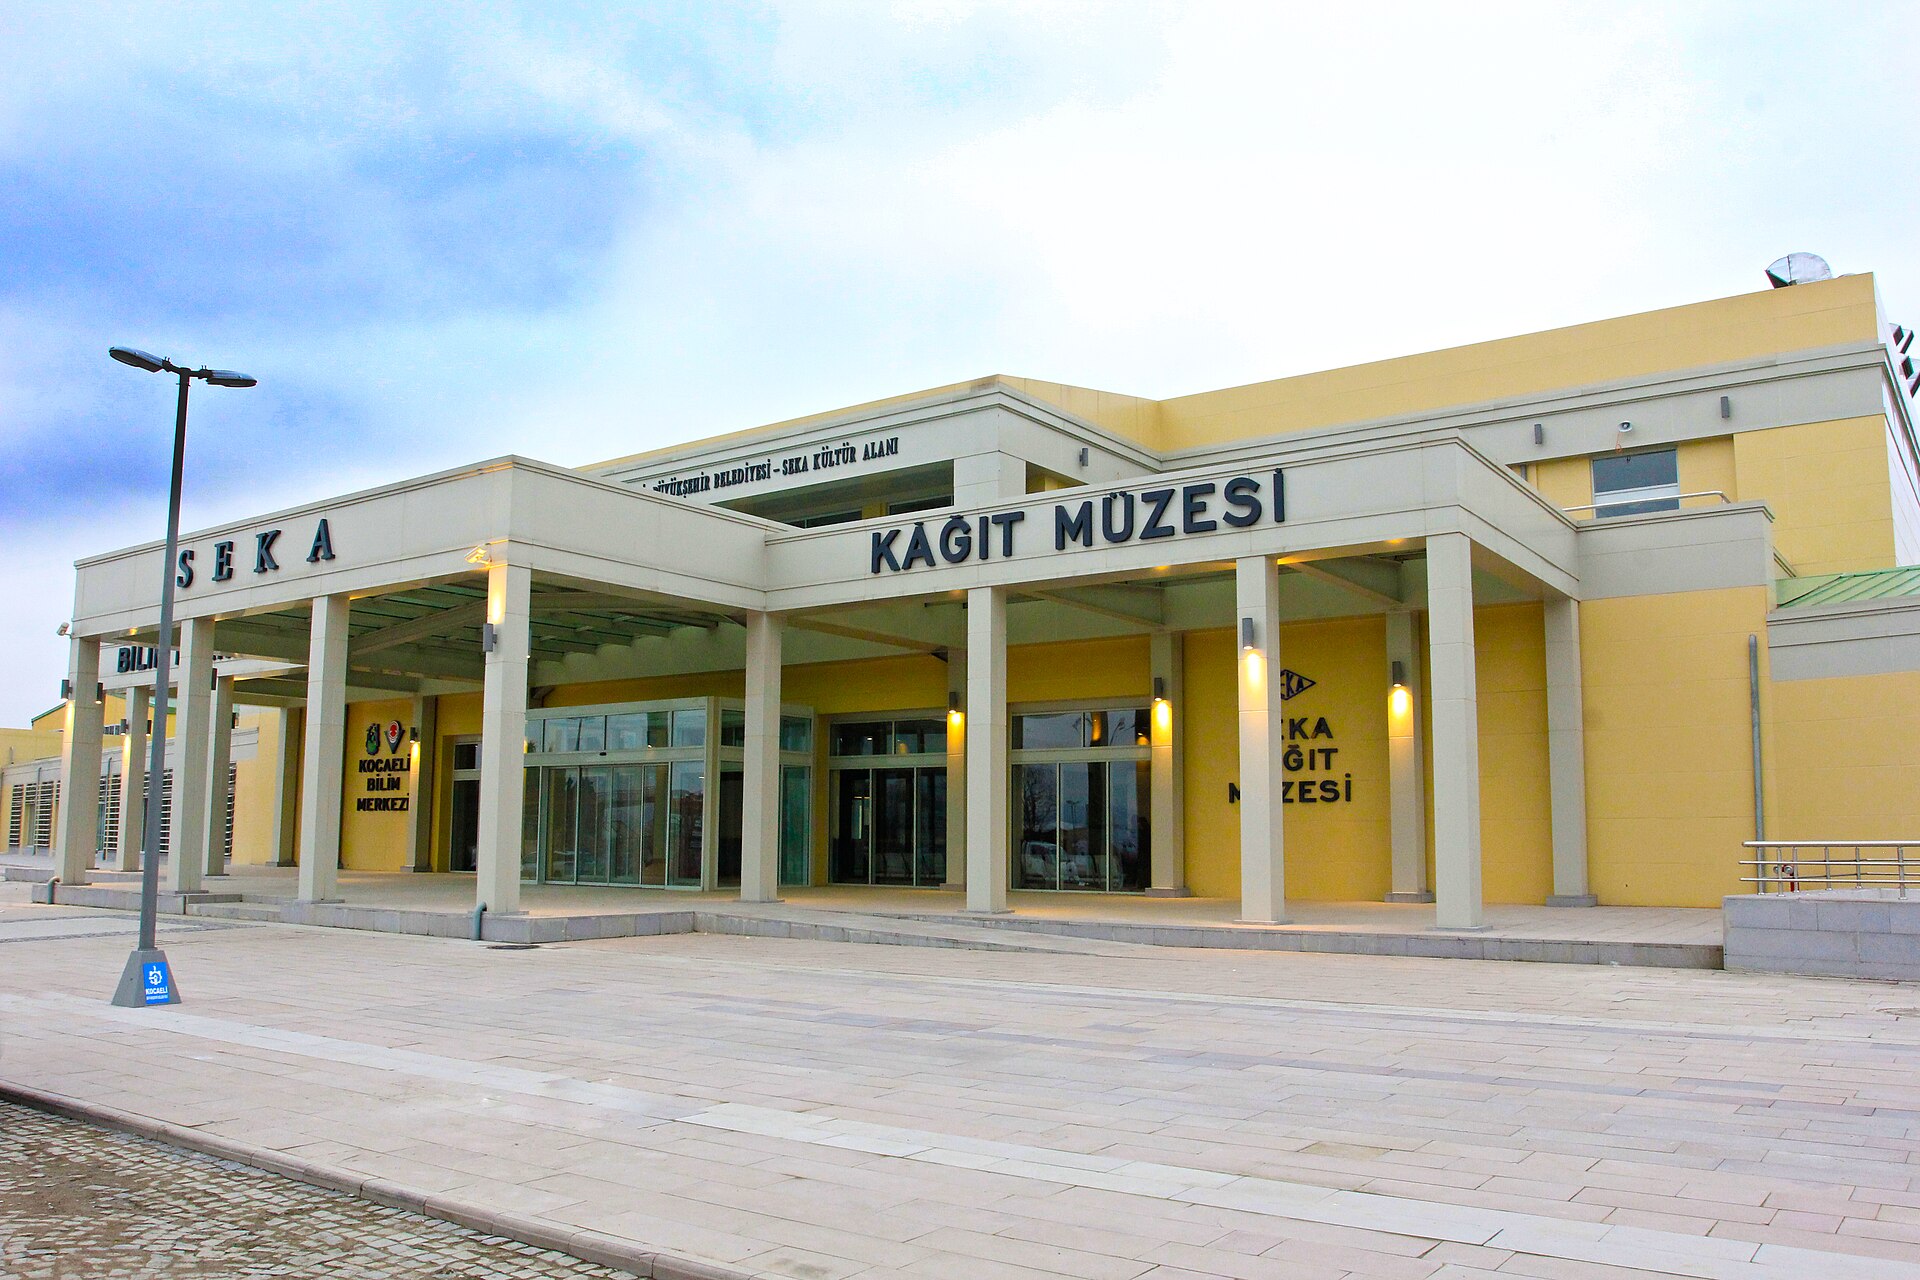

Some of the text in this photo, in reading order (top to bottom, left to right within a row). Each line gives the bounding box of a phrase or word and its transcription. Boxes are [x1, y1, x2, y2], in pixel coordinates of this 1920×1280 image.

[653, 471, 711, 499] ÜYÜKŞEHİR
[713, 459, 771, 488] BELEDİYESİ
[782, 455, 808, 476] SEKA
[813, 442, 857, 470] KÜLTÜR
[863, 437, 899, 461] ALANI
[1055, 468, 1286, 550] MÜZESİ
[176, 518, 336, 588] SEKA
[1281, 717, 1333, 740] KA
[359, 753, 411, 773] KOCAELİ
[1283, 744, 1338, 771] ĞIT
[366, 773, 401, 791] BİLİM
[1228, 773, 1352, 803] MZESİ
[356, 792, 410, 811] MERKEZİ
